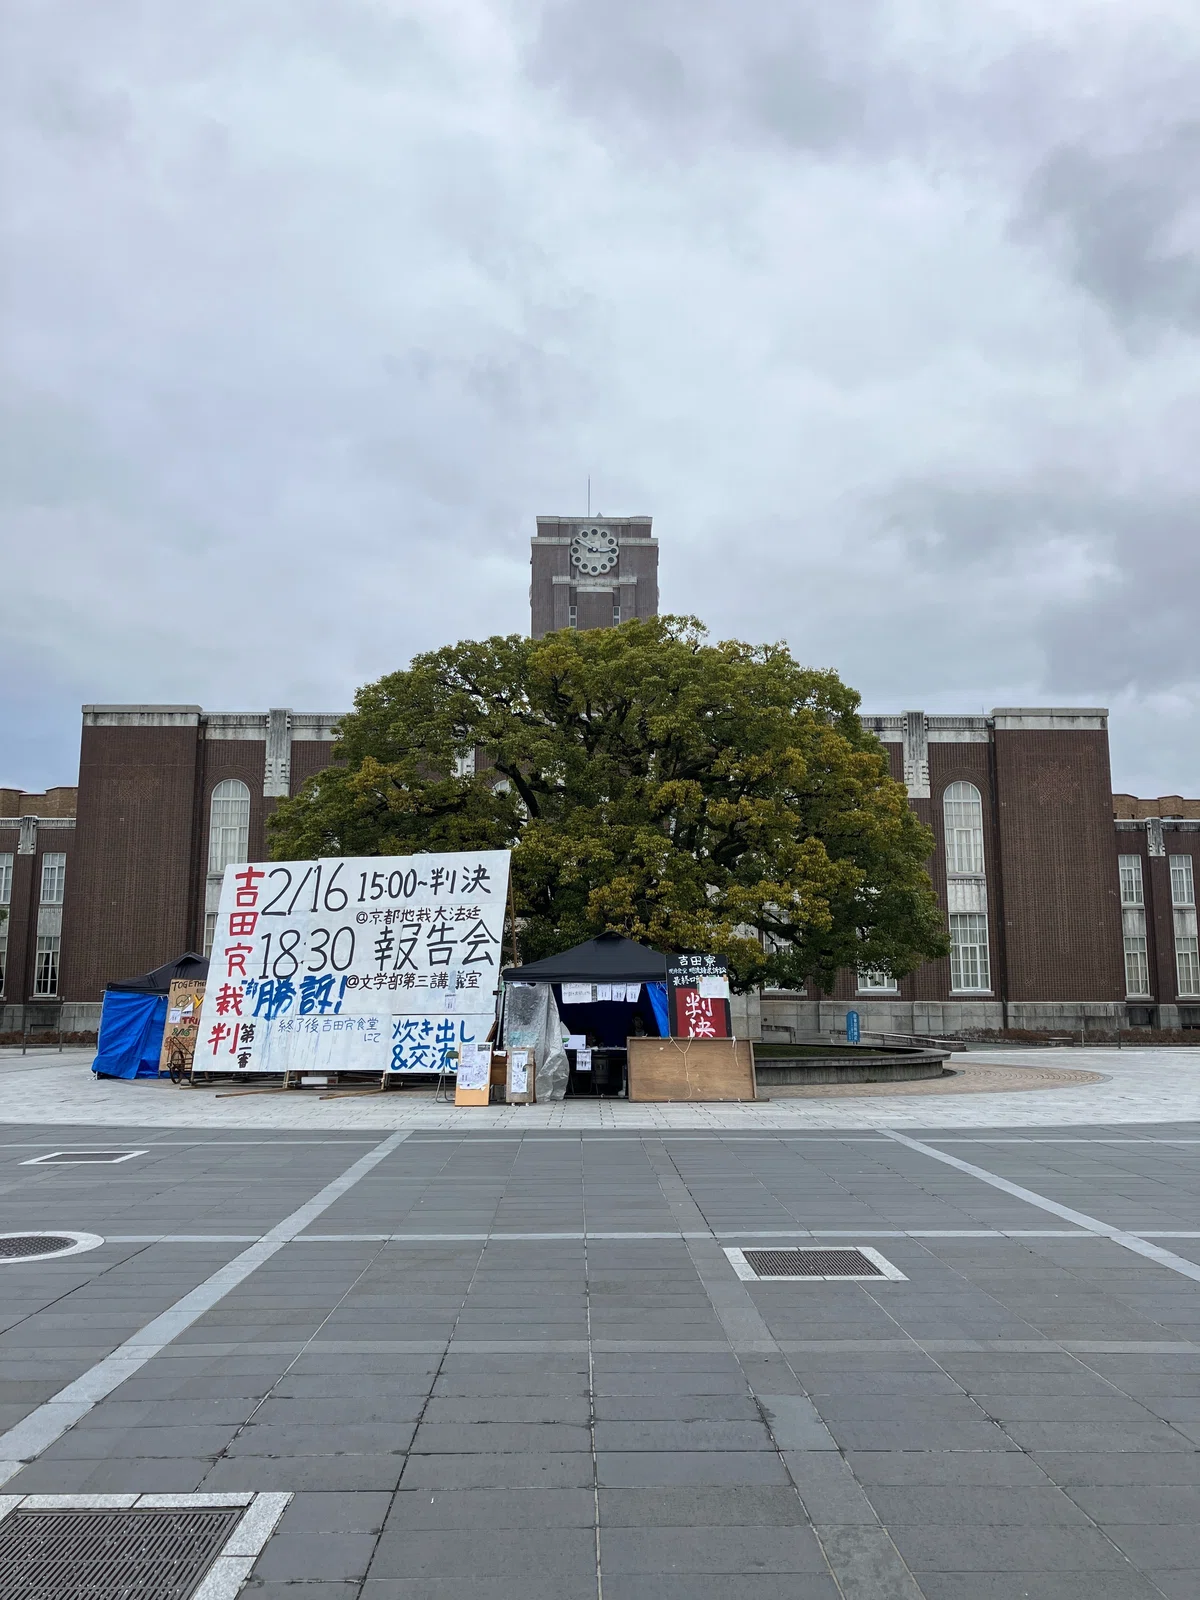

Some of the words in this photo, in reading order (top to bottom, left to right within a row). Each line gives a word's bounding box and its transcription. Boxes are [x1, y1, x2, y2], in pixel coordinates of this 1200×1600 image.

[261, 862, 349, 916] 2/16
[356, 905, 482, 925] @京都地裁大法廷
[258, 926, 356, 979] 18:30
[374, 919, 501, 971] 報告会
[678, 954, 716, 967] 吉田寮
[392, 1018, 476, 1044] 炊き出し
[685, 992, 716, 1038] 判決
[237, 1023, 256, 1068] 第一審
[363, 1033, 381, 1043] にて
[390, 1042, 458, 1071] &交流
